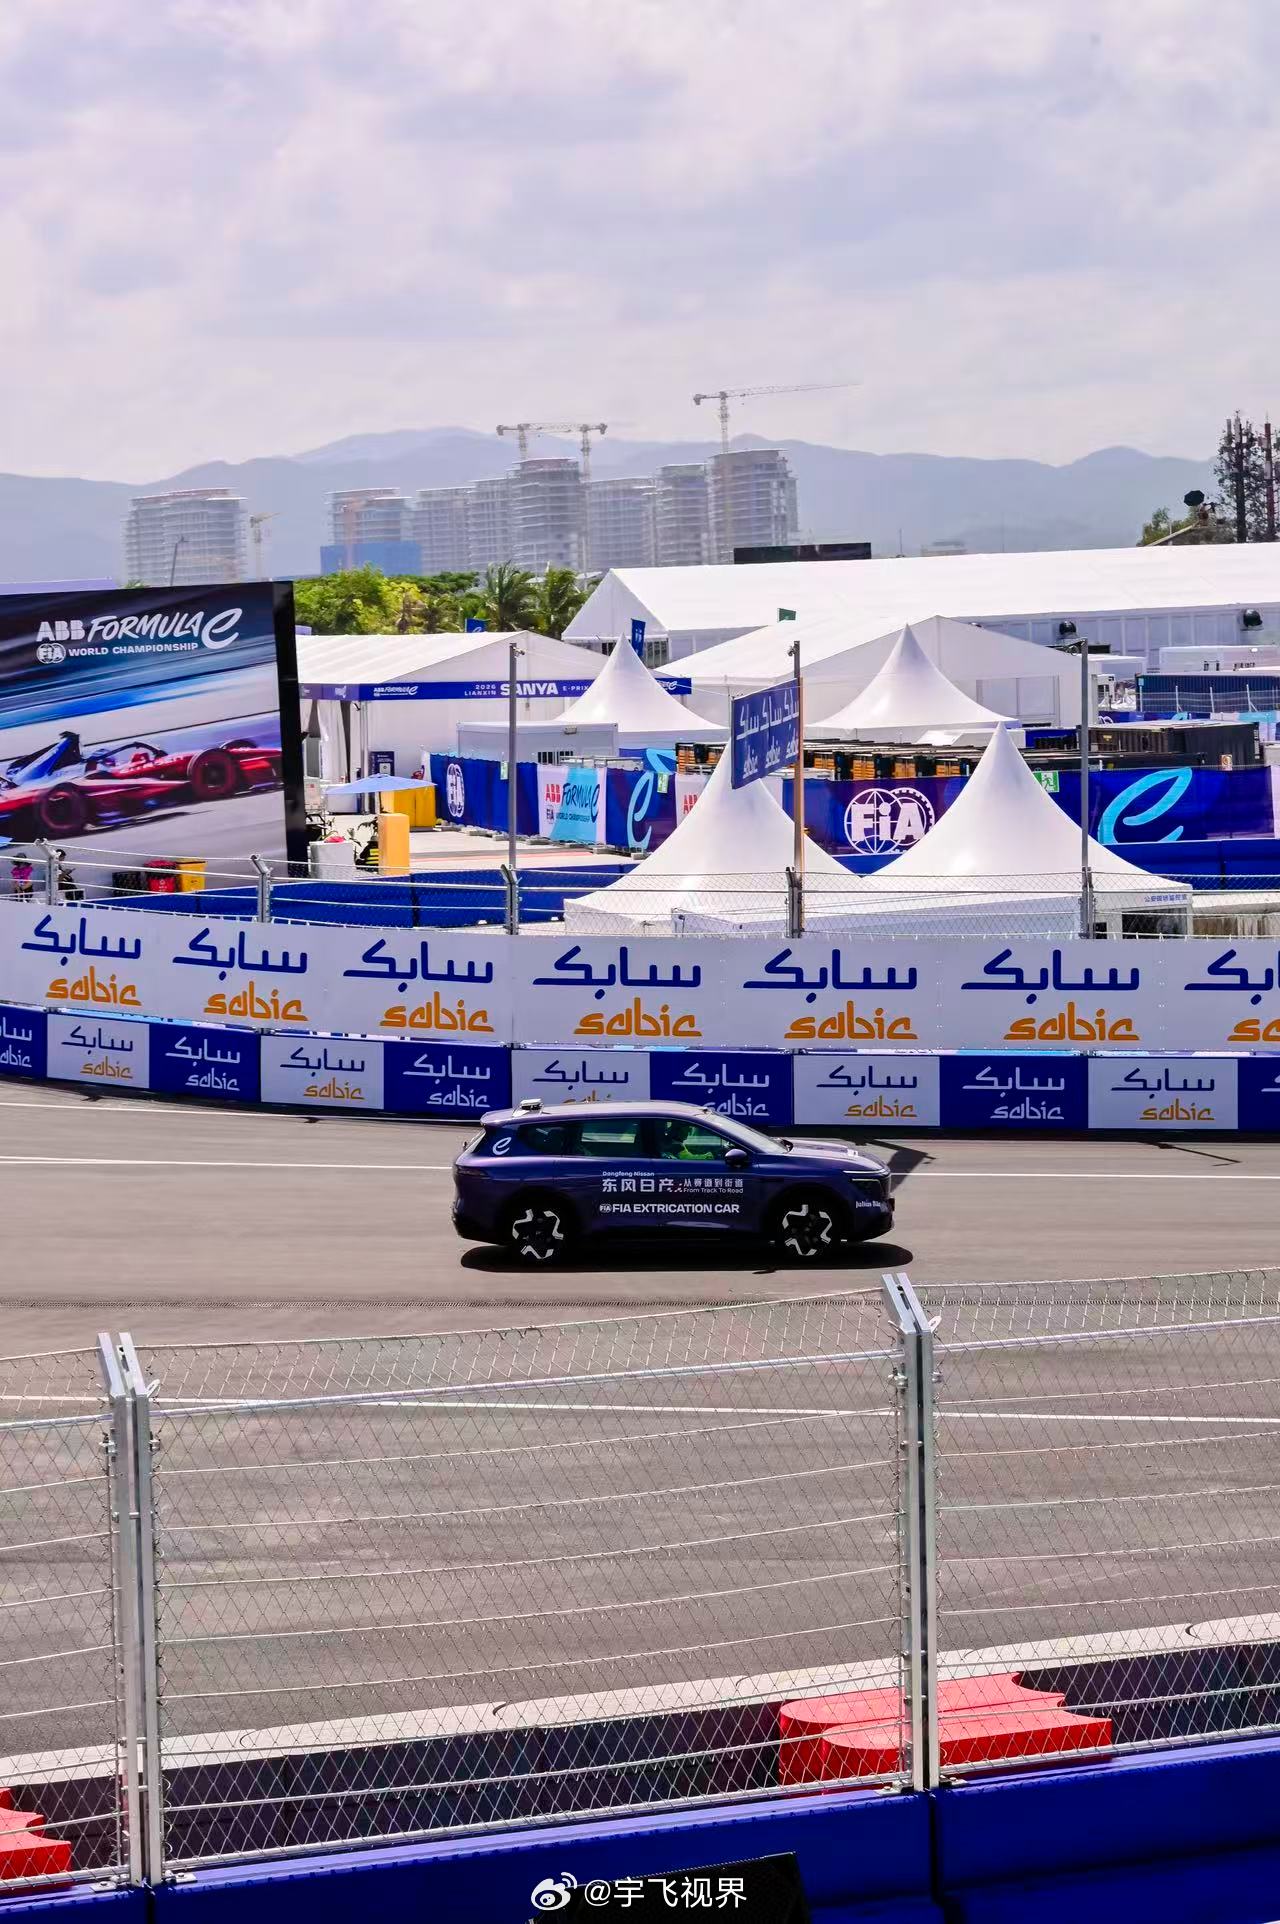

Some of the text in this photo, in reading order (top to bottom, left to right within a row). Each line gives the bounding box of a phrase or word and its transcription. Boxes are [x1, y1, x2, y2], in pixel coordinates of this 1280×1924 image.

[36, 619, 86, 642] ABB
[87, 611, 205, 642] FORMULA
[69, 647, 108, 657] WORLD
[112, 642, 198, 654] CHAMPIONSHIP
[500, 682, 559, 696] SANYA
[545, 784, 561, 803] ABB
[562, 783, 592, 808] FORMULA
[45, 965, 142, 1006] sabic
[203, 980, 308, 1021] sabic
[379, 991, 494, 1032] sabic
[574, 997, 702, 1037] sabic
[784, 1000, 918, 1039] sabic
[1003, 1001, 1140, 1041] sabic
[0, 1044, 32, 1068] abic
[80, 1055, 133, 1079] sabic
[185, 1067, 240, 1092] sabic
[303, 1077, 366, 1100] sabic
[427, 1085, 490, 1108] sabic
[844, 1095, 917, 1118] sabic
[990, 1097, 1064, 1120] sabic
[1138, 1098, 1215, 1120] sabic
[602, 1178, 674, 1193] 东风日产
[612, 1204, 631, 1213] FIA
[633, 1204, 713, 1213] EXTRICATION
[714, 1204, 740, 1213] CAR
